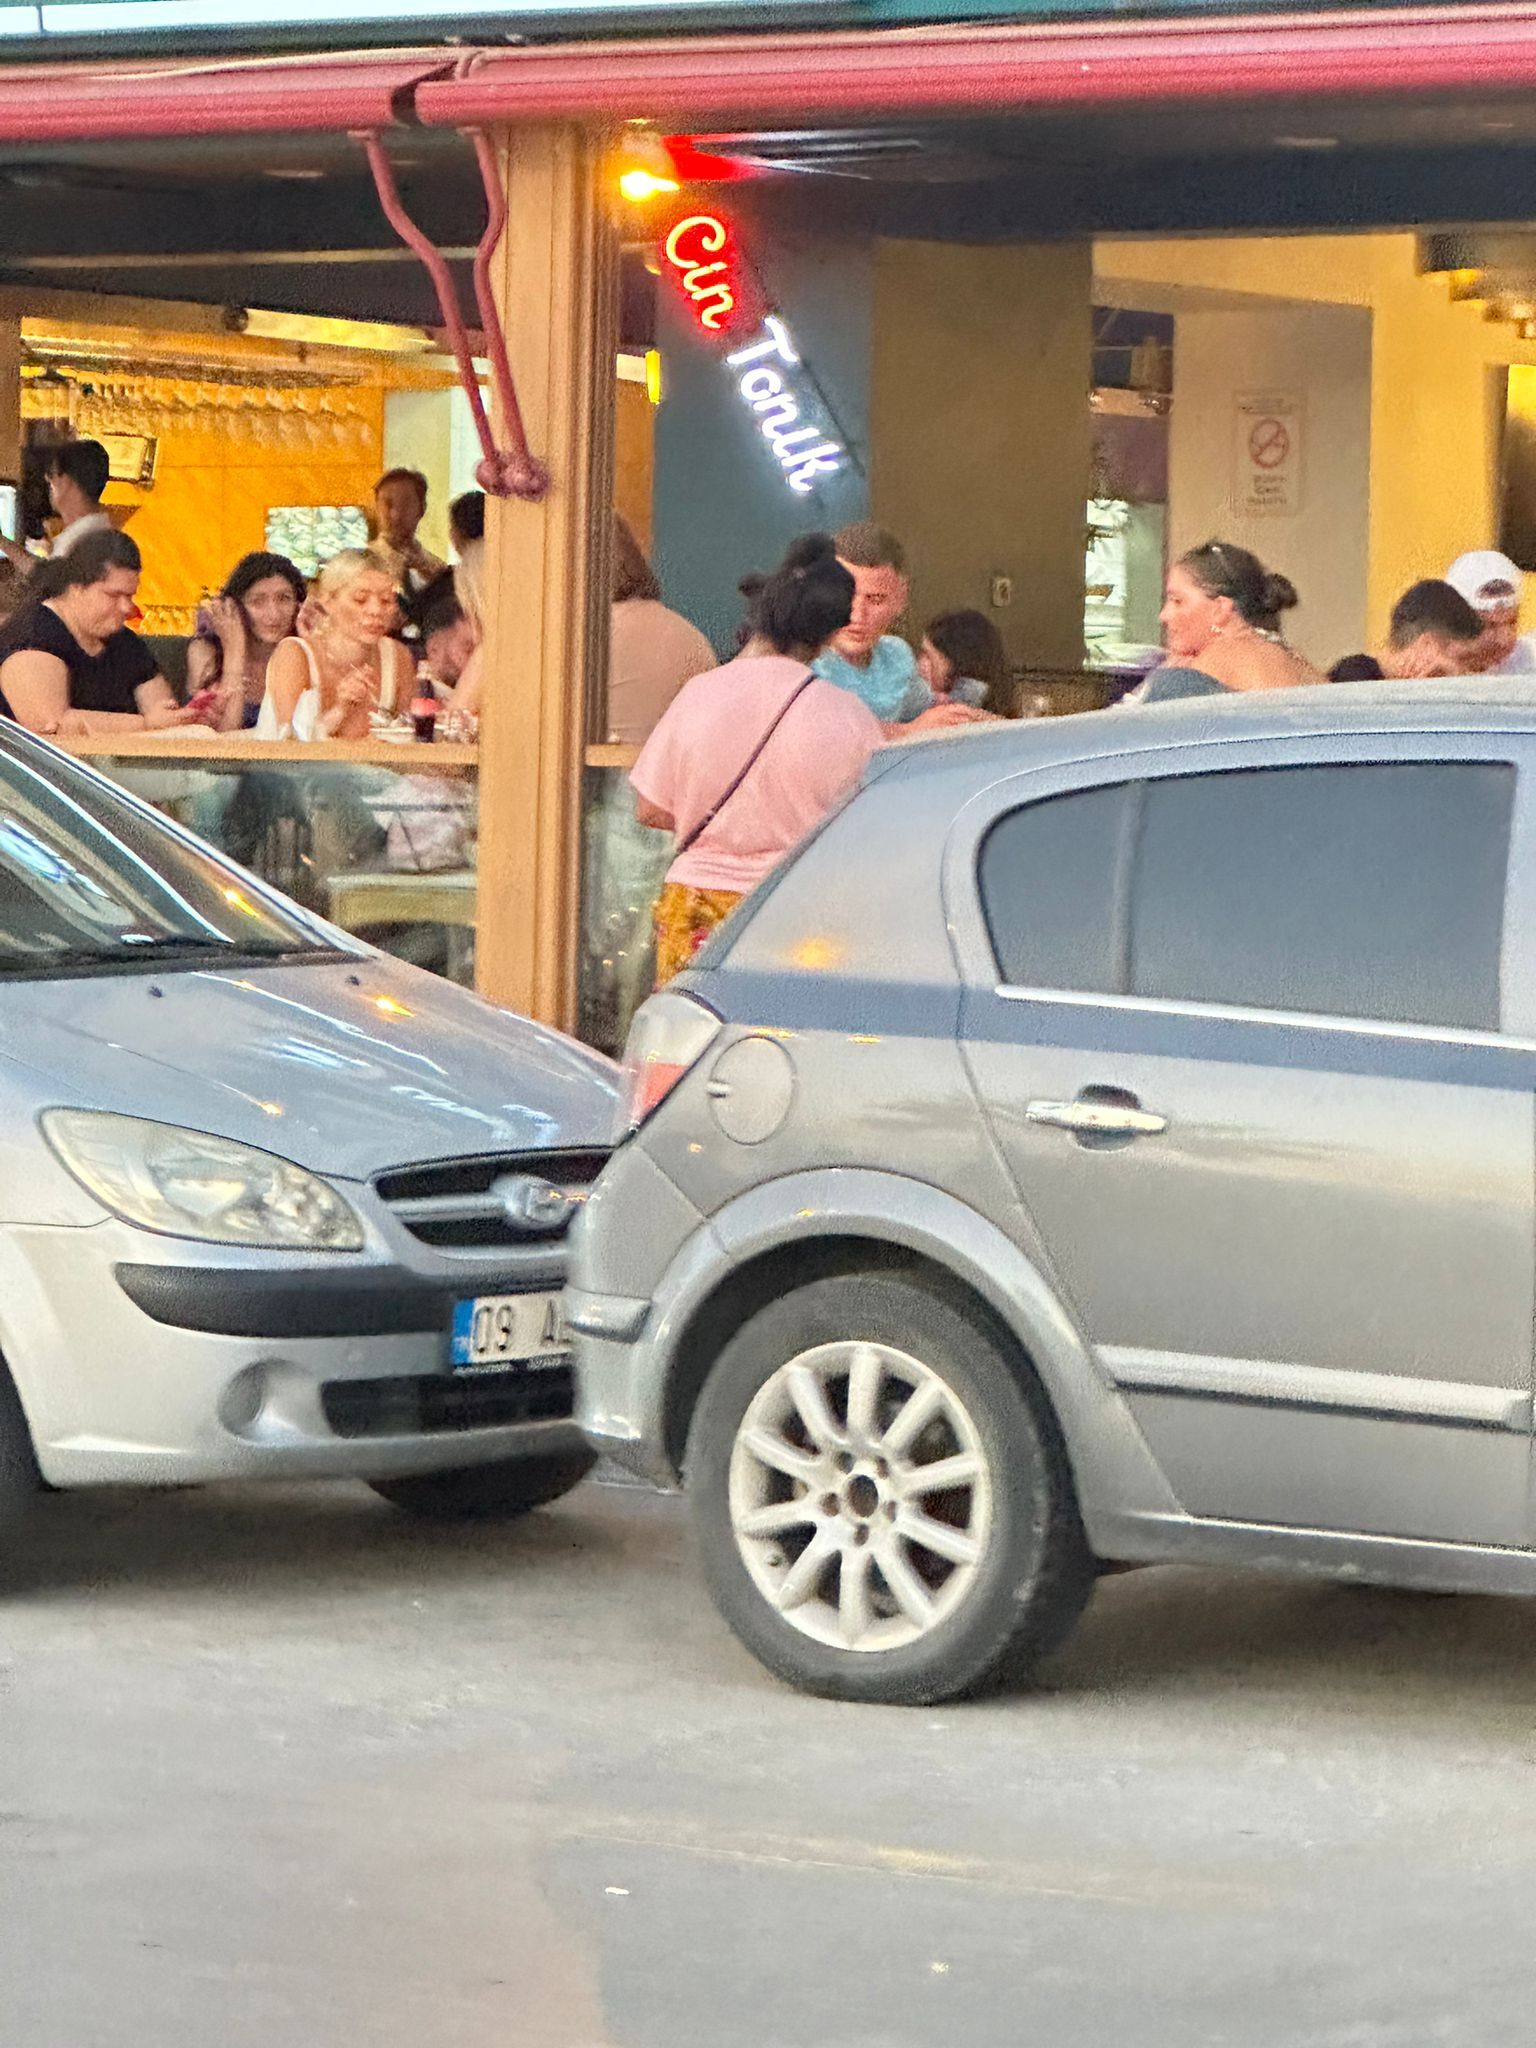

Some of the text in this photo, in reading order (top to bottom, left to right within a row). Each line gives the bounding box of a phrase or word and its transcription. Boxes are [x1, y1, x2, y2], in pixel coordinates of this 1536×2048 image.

[665, 215, 840, 491] Cin Tonik
[473, 1304, 513, 1353] 09
